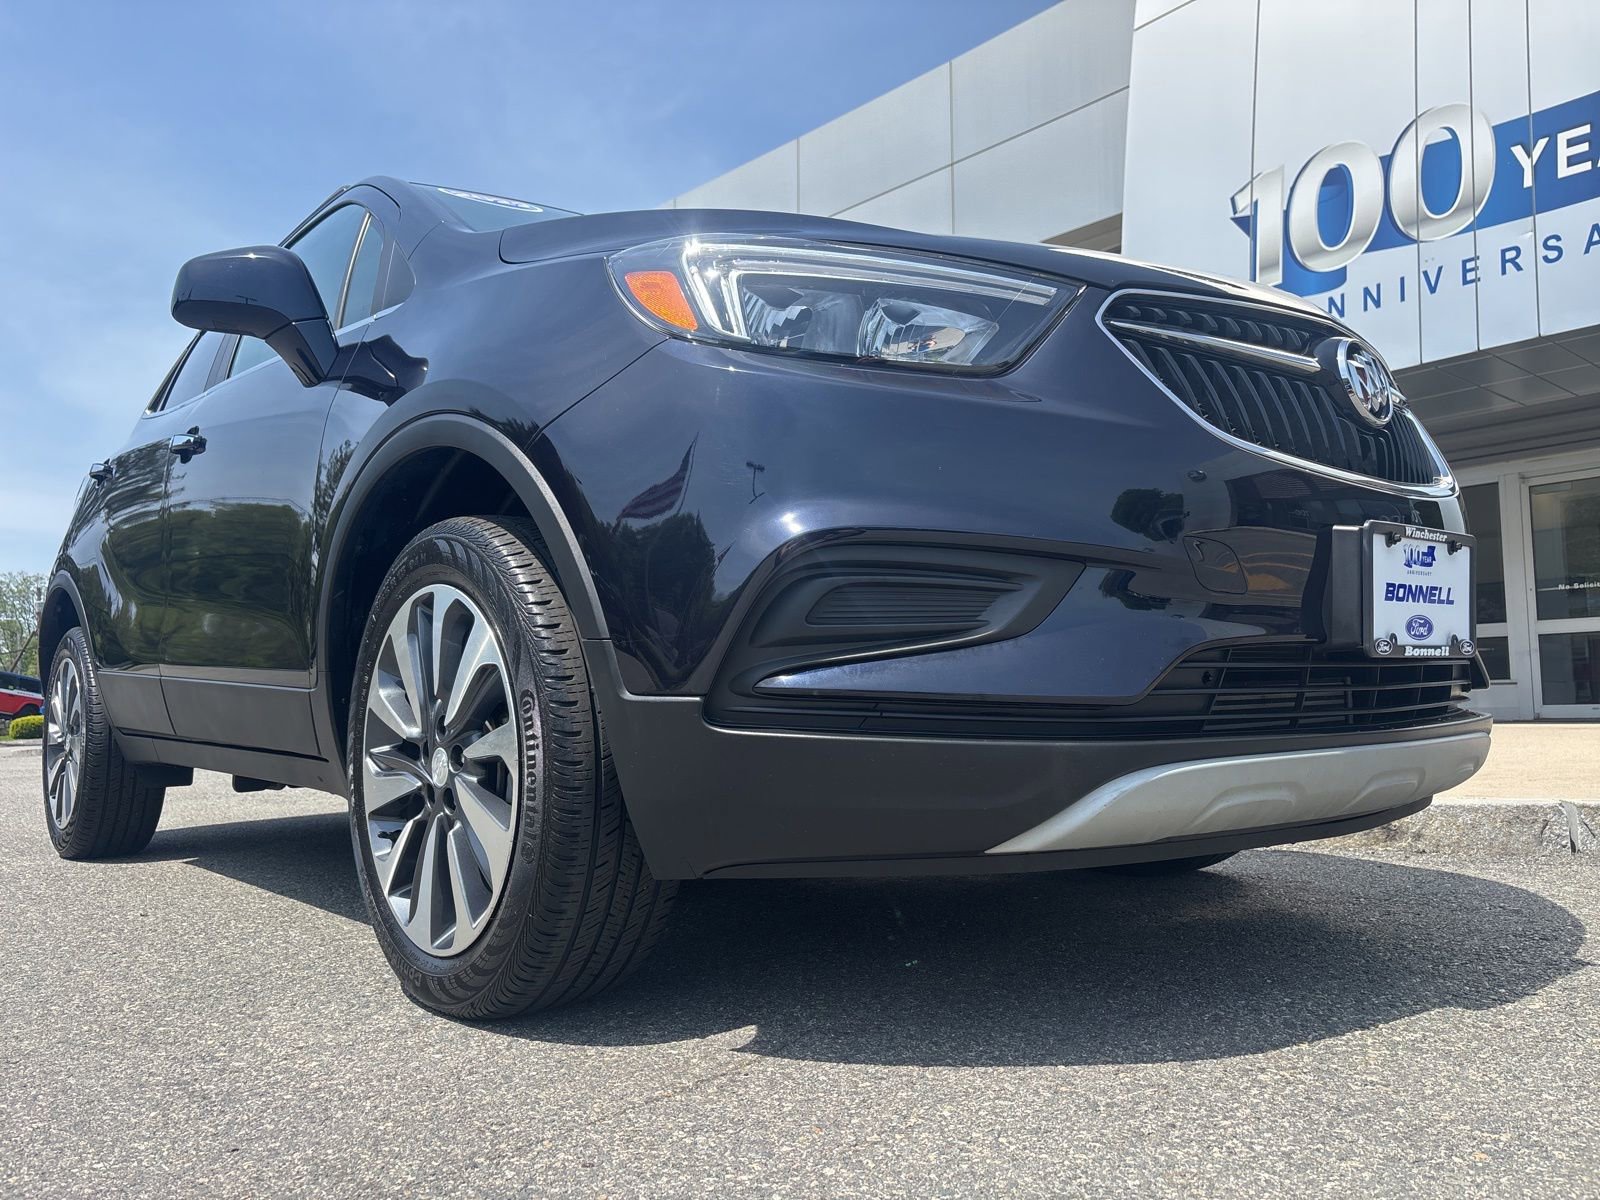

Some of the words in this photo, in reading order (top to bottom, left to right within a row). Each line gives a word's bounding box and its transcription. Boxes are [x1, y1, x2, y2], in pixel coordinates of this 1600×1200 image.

[1230, 102, 1496, 288] 100
[1510, 122, 1600, 189] YE
[1328, 222, 1600, 319] NNIVERSA
[1404, 526, 1448, 542] Winchester
[1384, 582, 1455, 605] BONNELL
[1410, 618, 1429, 636] Ford
[1404, 645, 1450, 657] Bonnell
[519, 689, 540, 841] Continental
